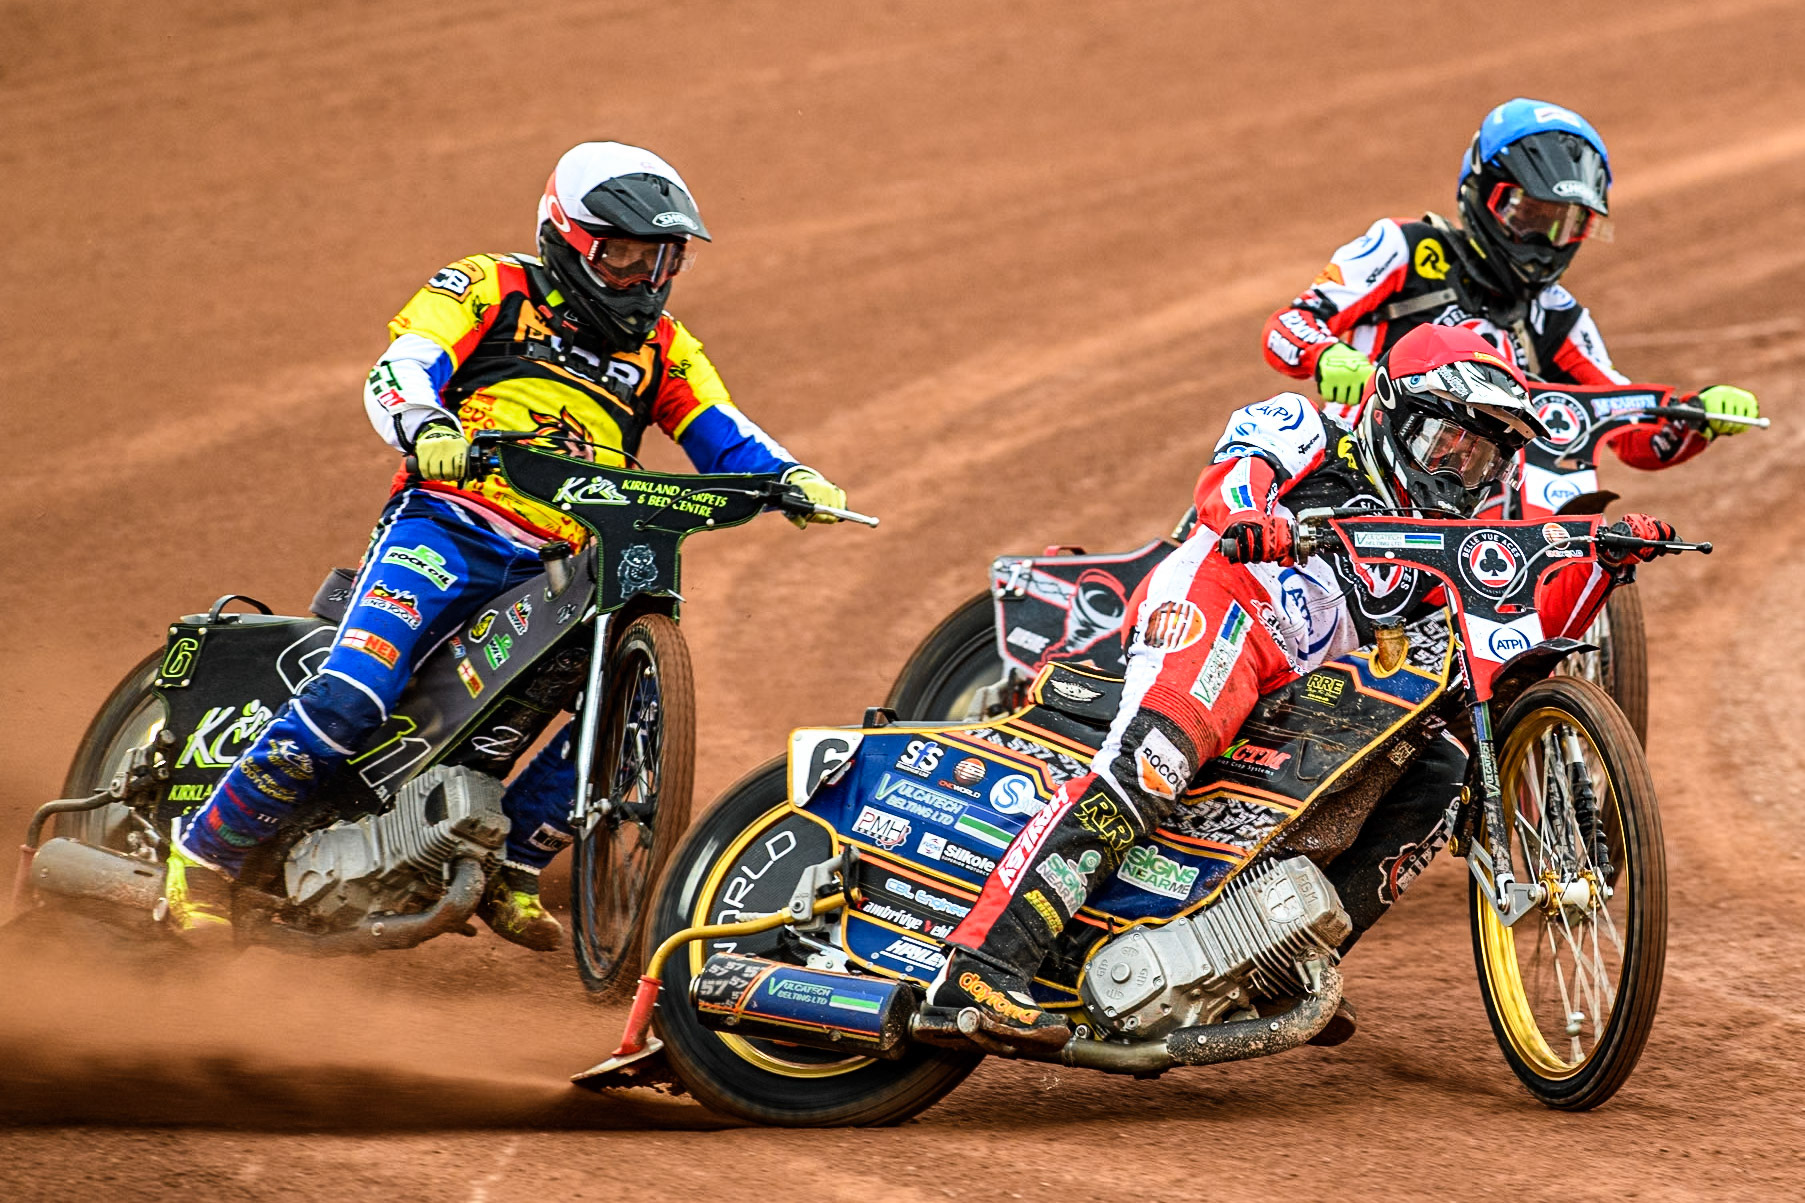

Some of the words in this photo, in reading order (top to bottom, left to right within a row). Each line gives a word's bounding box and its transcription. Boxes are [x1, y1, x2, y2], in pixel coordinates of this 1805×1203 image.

[622, 479, 680, 496] KIRKLAND
[648, 494, 672, 508] BED
[1462, 535, 1479, 559] BELLE
[1481, 533, 1500, 543] VUE
[1501, 538, 1521, 559] ACES
[388, 551, 428, 569] ROCK
[428, 565, 451, 585] OIL
[162, 637, 198, 678] 6
[1496, 639, 1524, 650] ATPI
[1308, 674, 1345, 694] RRE
[806, 738, 850, 797] 6
[1232, 744, 1292, 770] CTM
[1246, 764, 1275, 776] Systems
[876, 773, 964, 814] VULCATECH
[886, 795, 932, 819] BELTING
[932, 811, 955, 826] LTD
[1080, 792, 1135, 851] RR
[858, 811, 905, 841] PMH
[943, 844, 997, 872] Silkole
[1127, 848, 1198, 884] SIGNS
[1038, 865, 1071, 900] NEAR
[1122, 863, 1170, 890] NEAR
[1168, 882, 1192, 896] ME
[856, 897, 924, 930] Cambridge
[709, 964, 729, 976] 57
[742, 964, 765, 978] 5
[700, 980, 729, 996] 57
[769, 977, 831, 996] VULCATECH
[778, 991, 812, 1003] BELTING
[812, 995, 828, 1005] LTD
[959, 971, 1042, 1025] daytona
